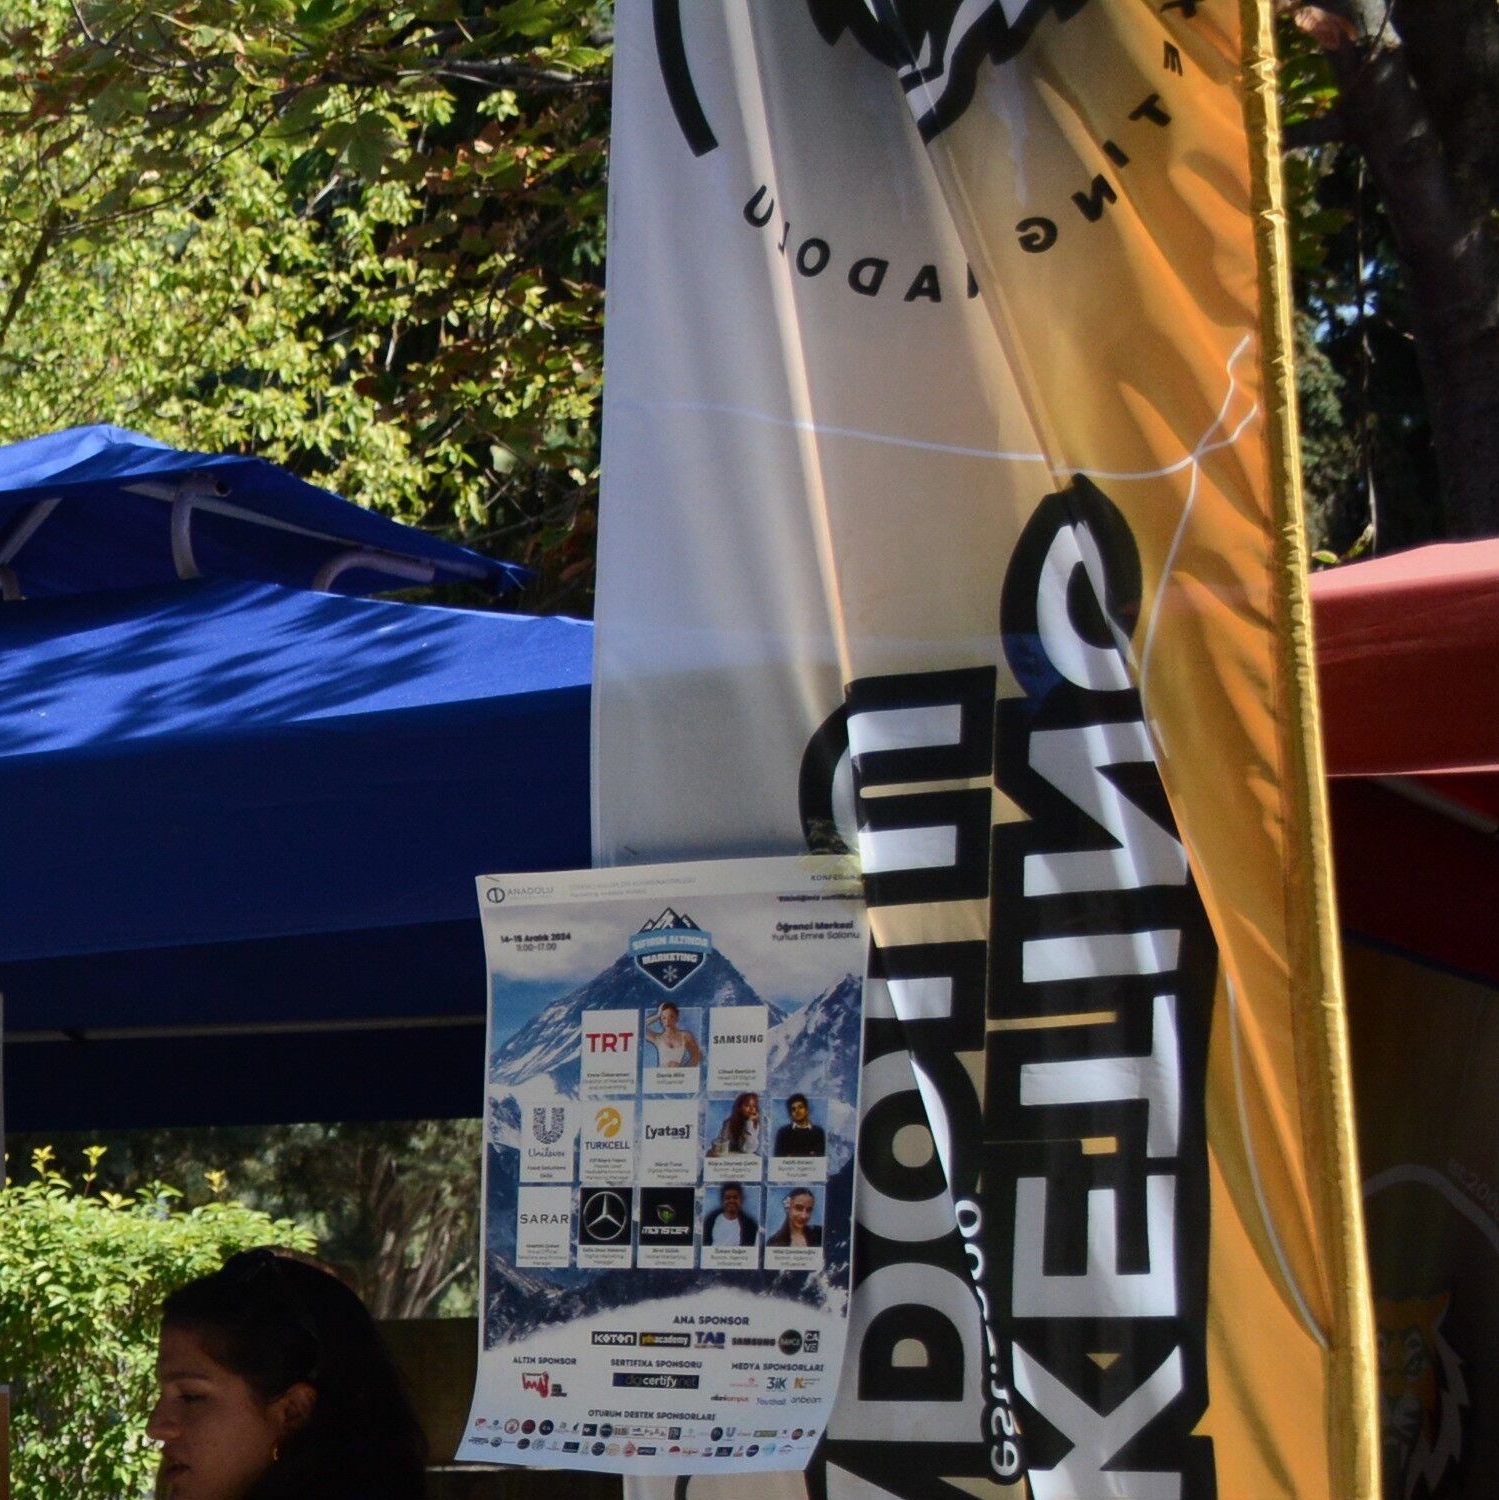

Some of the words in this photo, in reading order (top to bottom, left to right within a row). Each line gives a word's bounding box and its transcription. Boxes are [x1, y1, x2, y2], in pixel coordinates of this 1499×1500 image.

[771, 933, 798, 942] Yunus
[800, 932, 825, 940] Emre
[585, 1032, 635, 1053] TRT
[712, 1033, 765, 1045] SAMSUNG
[585, 1140, 631, 1150] TURKCELL
[519, 1213, 569, 1225] SARAR
[673, 1316, 695, 1325] ANA
[698, 1315, 750, 1326] SPONSOR
[695, 1332, 725, 1345] TAB
[538, 1357, 577, 1366] SPONSOR
[654, 1361, 702, 1370] SPONSORU
[731, 1362, 759, 1372] MEDYA
[587, 1409, 621, 1419] OTURUM
[623, 1411, 655, 1419] DESTEK
